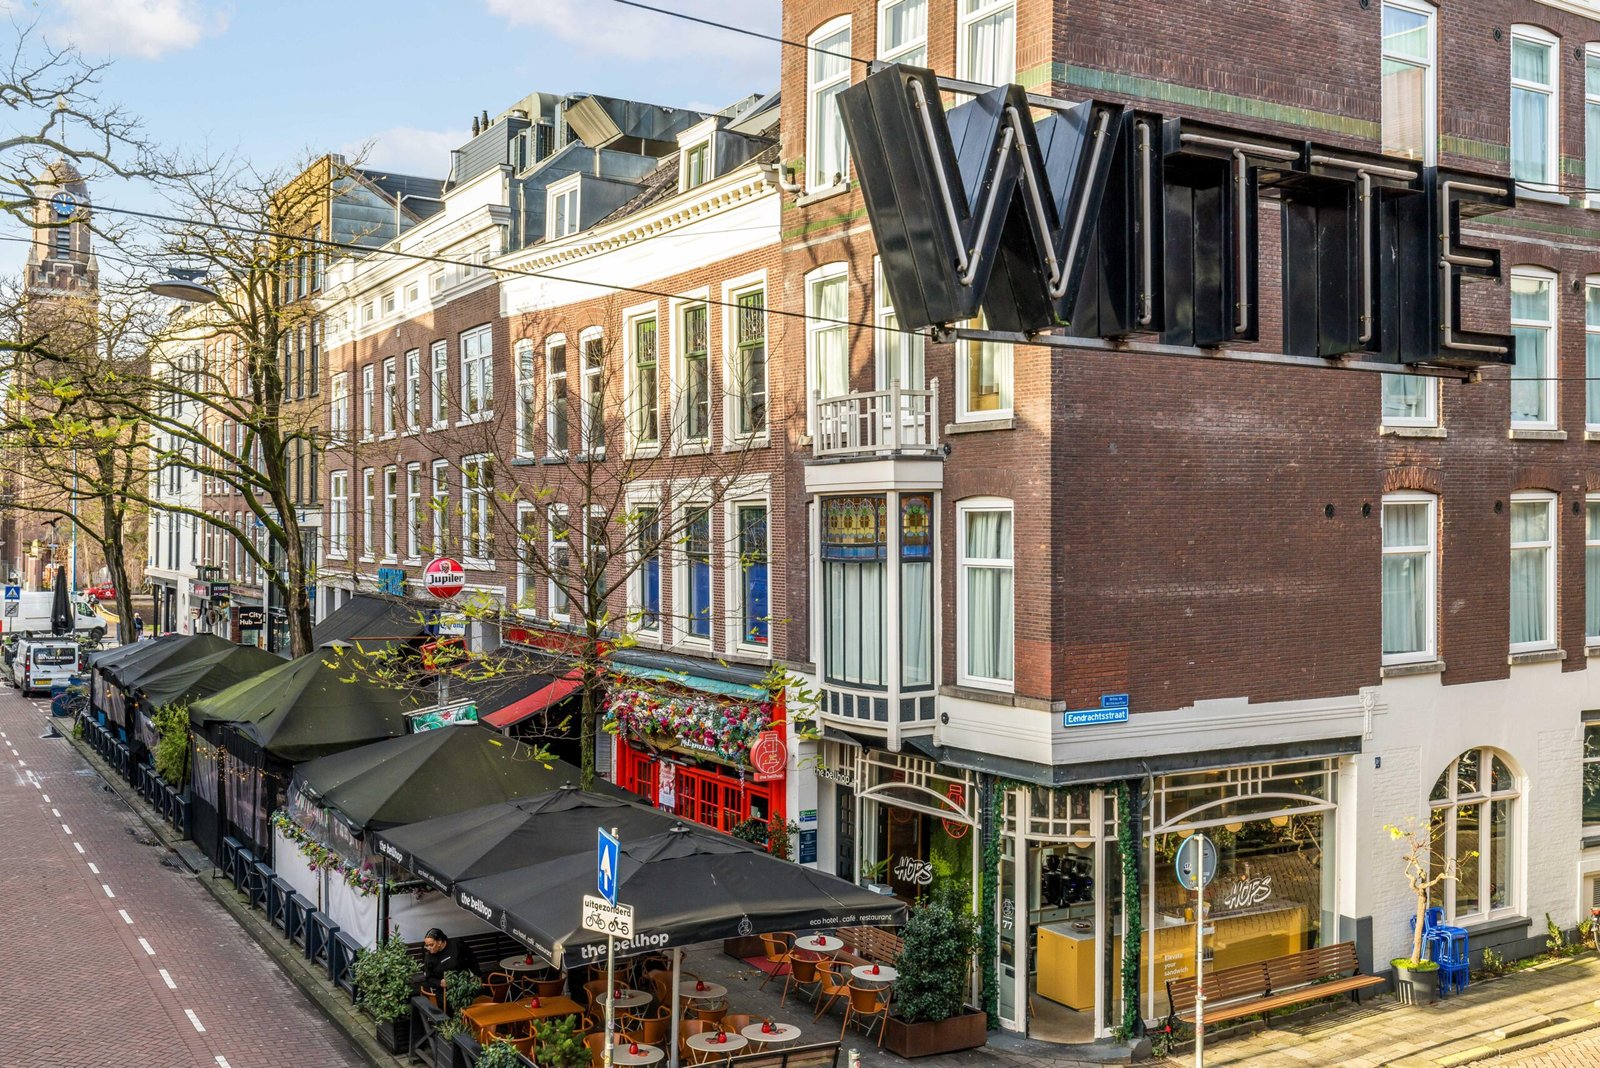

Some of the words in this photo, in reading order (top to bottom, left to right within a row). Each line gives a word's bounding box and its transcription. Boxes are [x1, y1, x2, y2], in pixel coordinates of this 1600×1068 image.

[837, 64, 1516, 366] WITTE
[428, 574, 463, 585] Jupiler
[1068, 710, 1126, 723] Eendrachtsstraat
[386, 843, 403, 864] bellhop
[894, 856, 933, 885] HOPS
[1224, 875, 1272, 909] HOPS
[461, 892, 470, 906] the
[470, 896, 492, 920] bellhop
[584, 899, 631, 917] uitgezonderd
[822, 916, 839, 924] hotel
[842, 914, 856, 922] café
[1002, 920, 1013, 930] 77
[581, 943, 607, 959] the
[1164, 962, 1176, 970] your
[1164, 966, 1189, 977] sandwich
